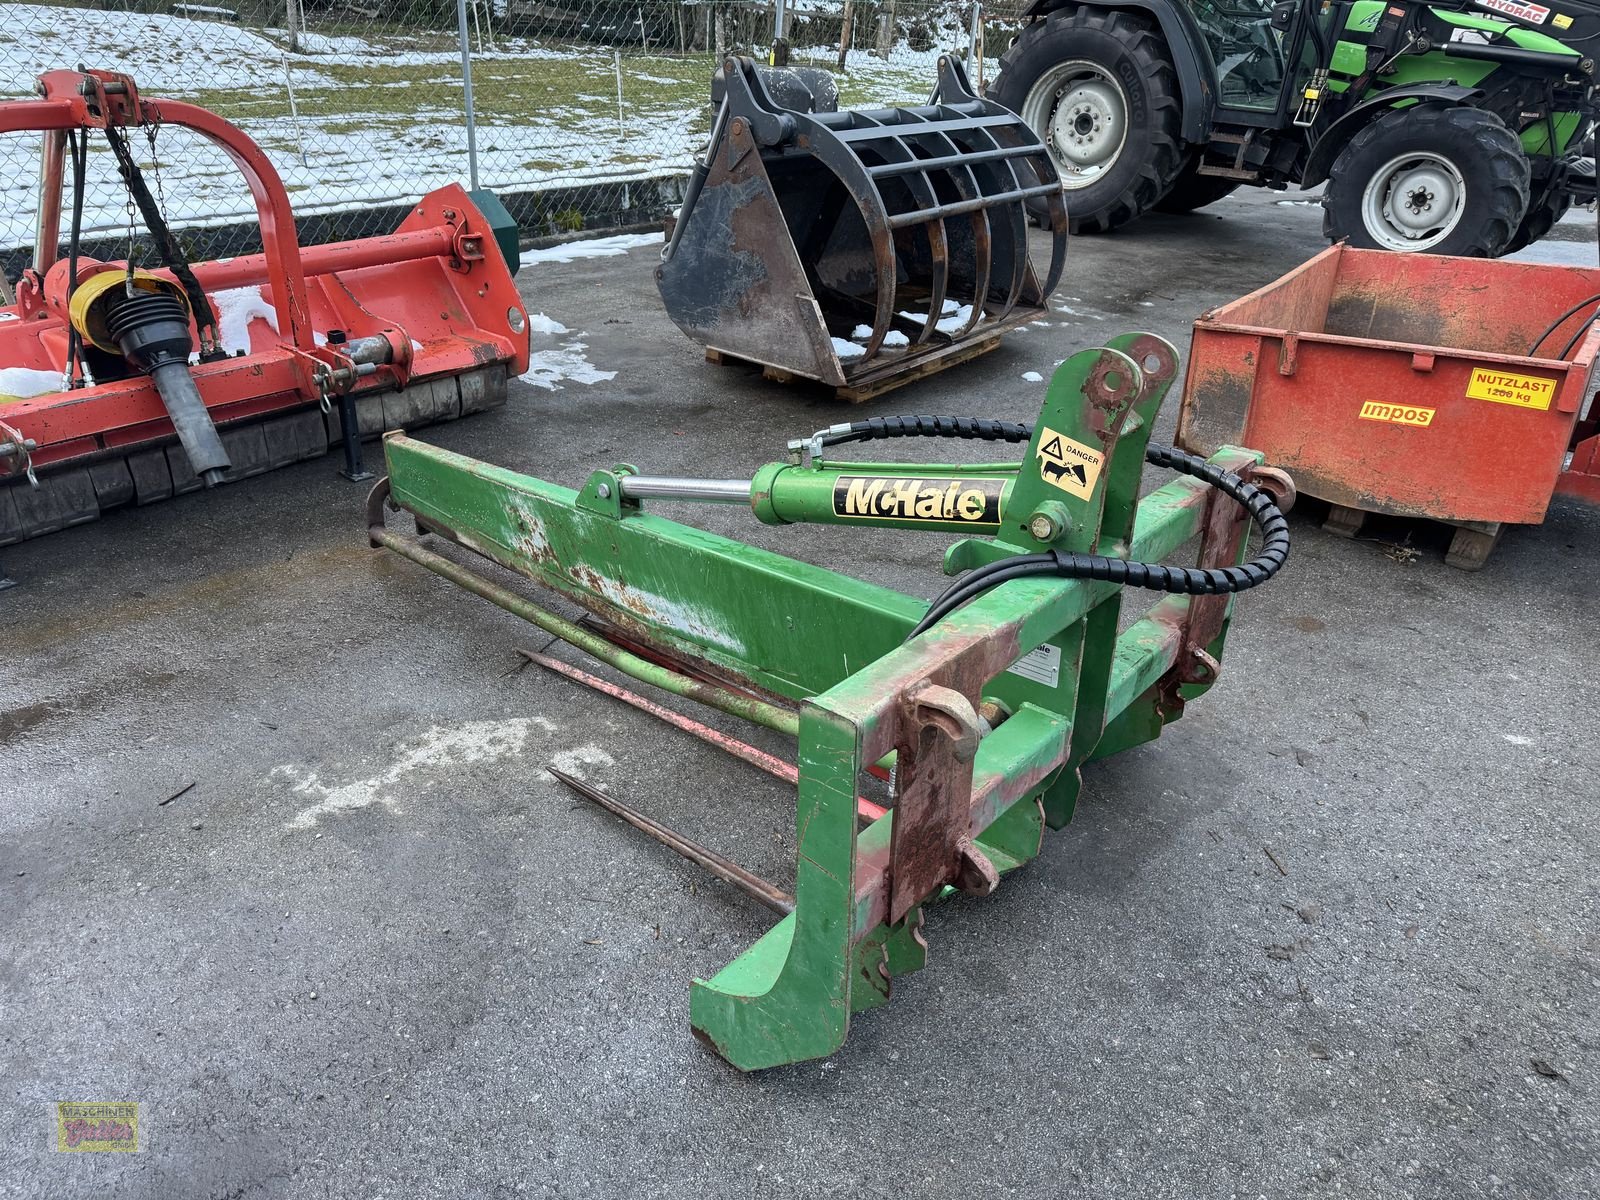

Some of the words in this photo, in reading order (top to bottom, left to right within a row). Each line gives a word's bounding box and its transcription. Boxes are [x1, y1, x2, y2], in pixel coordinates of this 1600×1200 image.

[1486, 0, 1543, 22] HYDRAC
[1476, 373, 1550, 393] NUTZLAST
[1516, 391, 1531, 403] kg
[1065, 445, 1099, 465] DANGER
[845, 478, 986, 520] McHale
